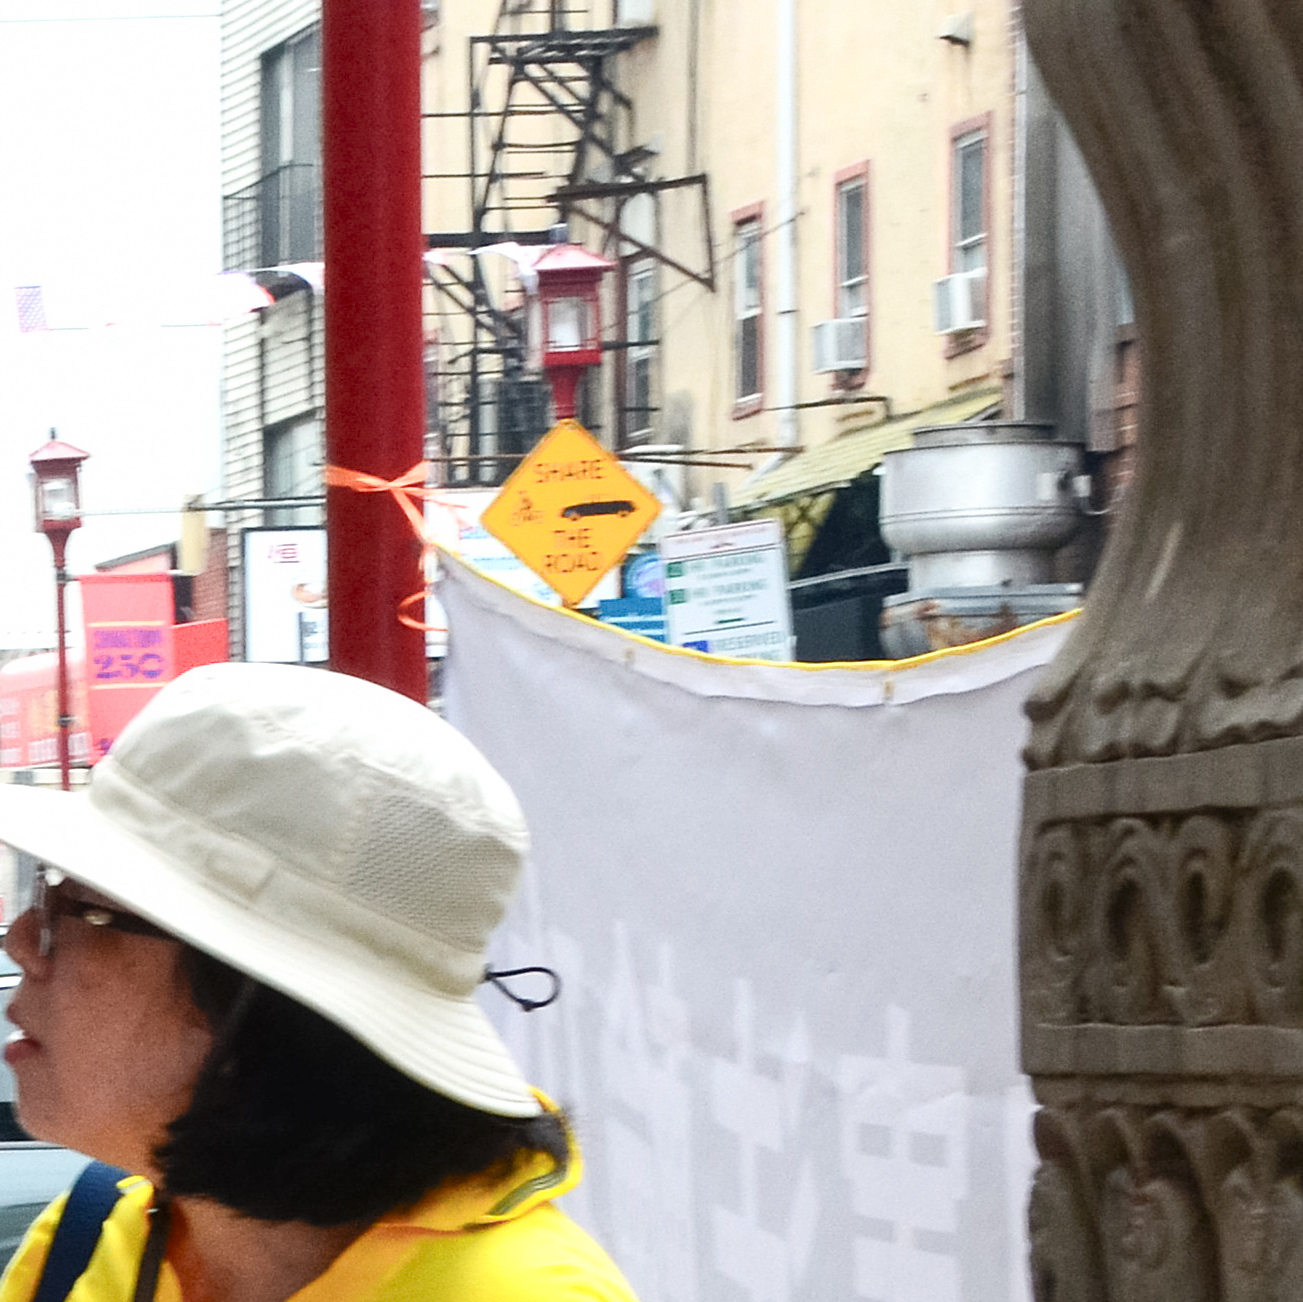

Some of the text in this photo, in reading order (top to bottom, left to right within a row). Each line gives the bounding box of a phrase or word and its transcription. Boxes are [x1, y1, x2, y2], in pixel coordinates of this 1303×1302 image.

[534, 459, 608, 484] SHARE
[553, 528, 593, 549] THE
[544, 551, 603, 573] ROAD
